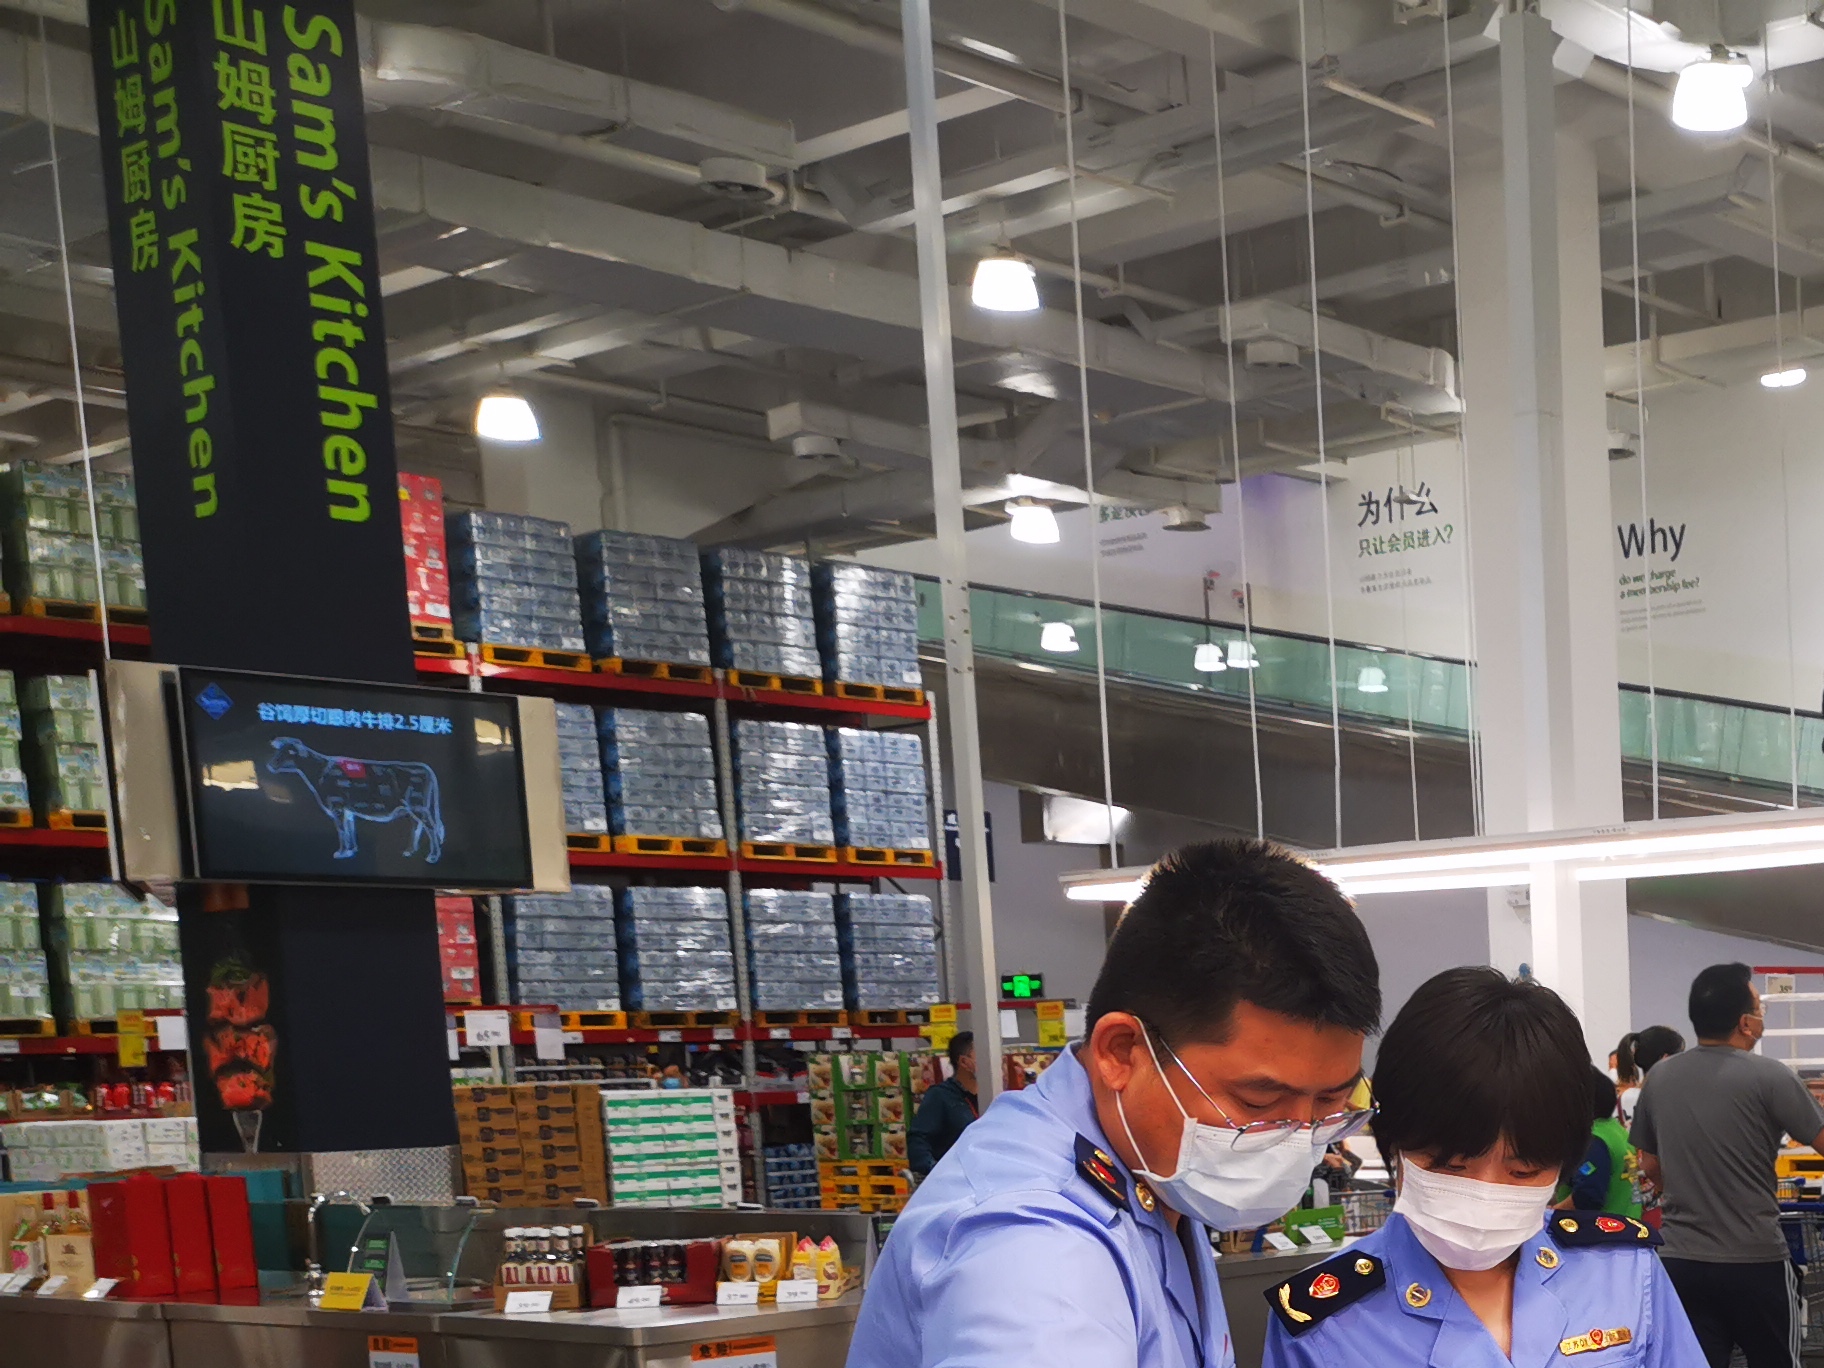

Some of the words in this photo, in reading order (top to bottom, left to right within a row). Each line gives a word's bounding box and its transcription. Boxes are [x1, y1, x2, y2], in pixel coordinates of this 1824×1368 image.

[110, 9, 160, 273] 山姆厨房
[211, 0, 288, 259] 山姆厨房
[282, 4, 358, 223] Sam's
[168, 227, 219, 519] Kitchen
[305, 240, 379, 523] Kitchen
[1358, 481, 1438, 527] 为什么
[1617, 517, 1687, 562] Why
